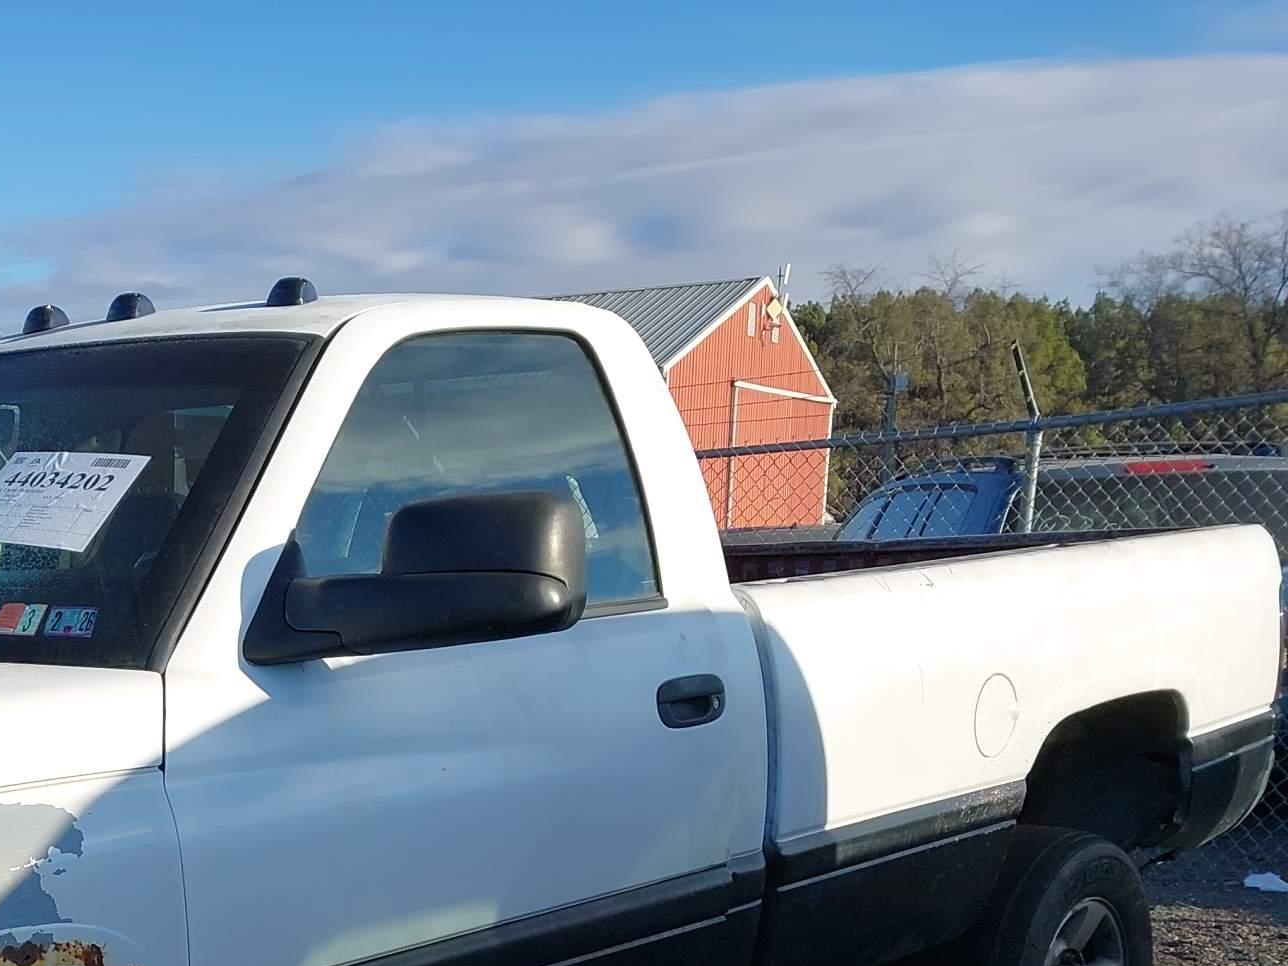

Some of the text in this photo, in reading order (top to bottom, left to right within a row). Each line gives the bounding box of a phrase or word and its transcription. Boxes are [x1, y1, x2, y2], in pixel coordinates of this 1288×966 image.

[4, 471, 115, 492] 44034202
[22, 608, 36, 633] 3
[51, 610, 63, 632] 2
